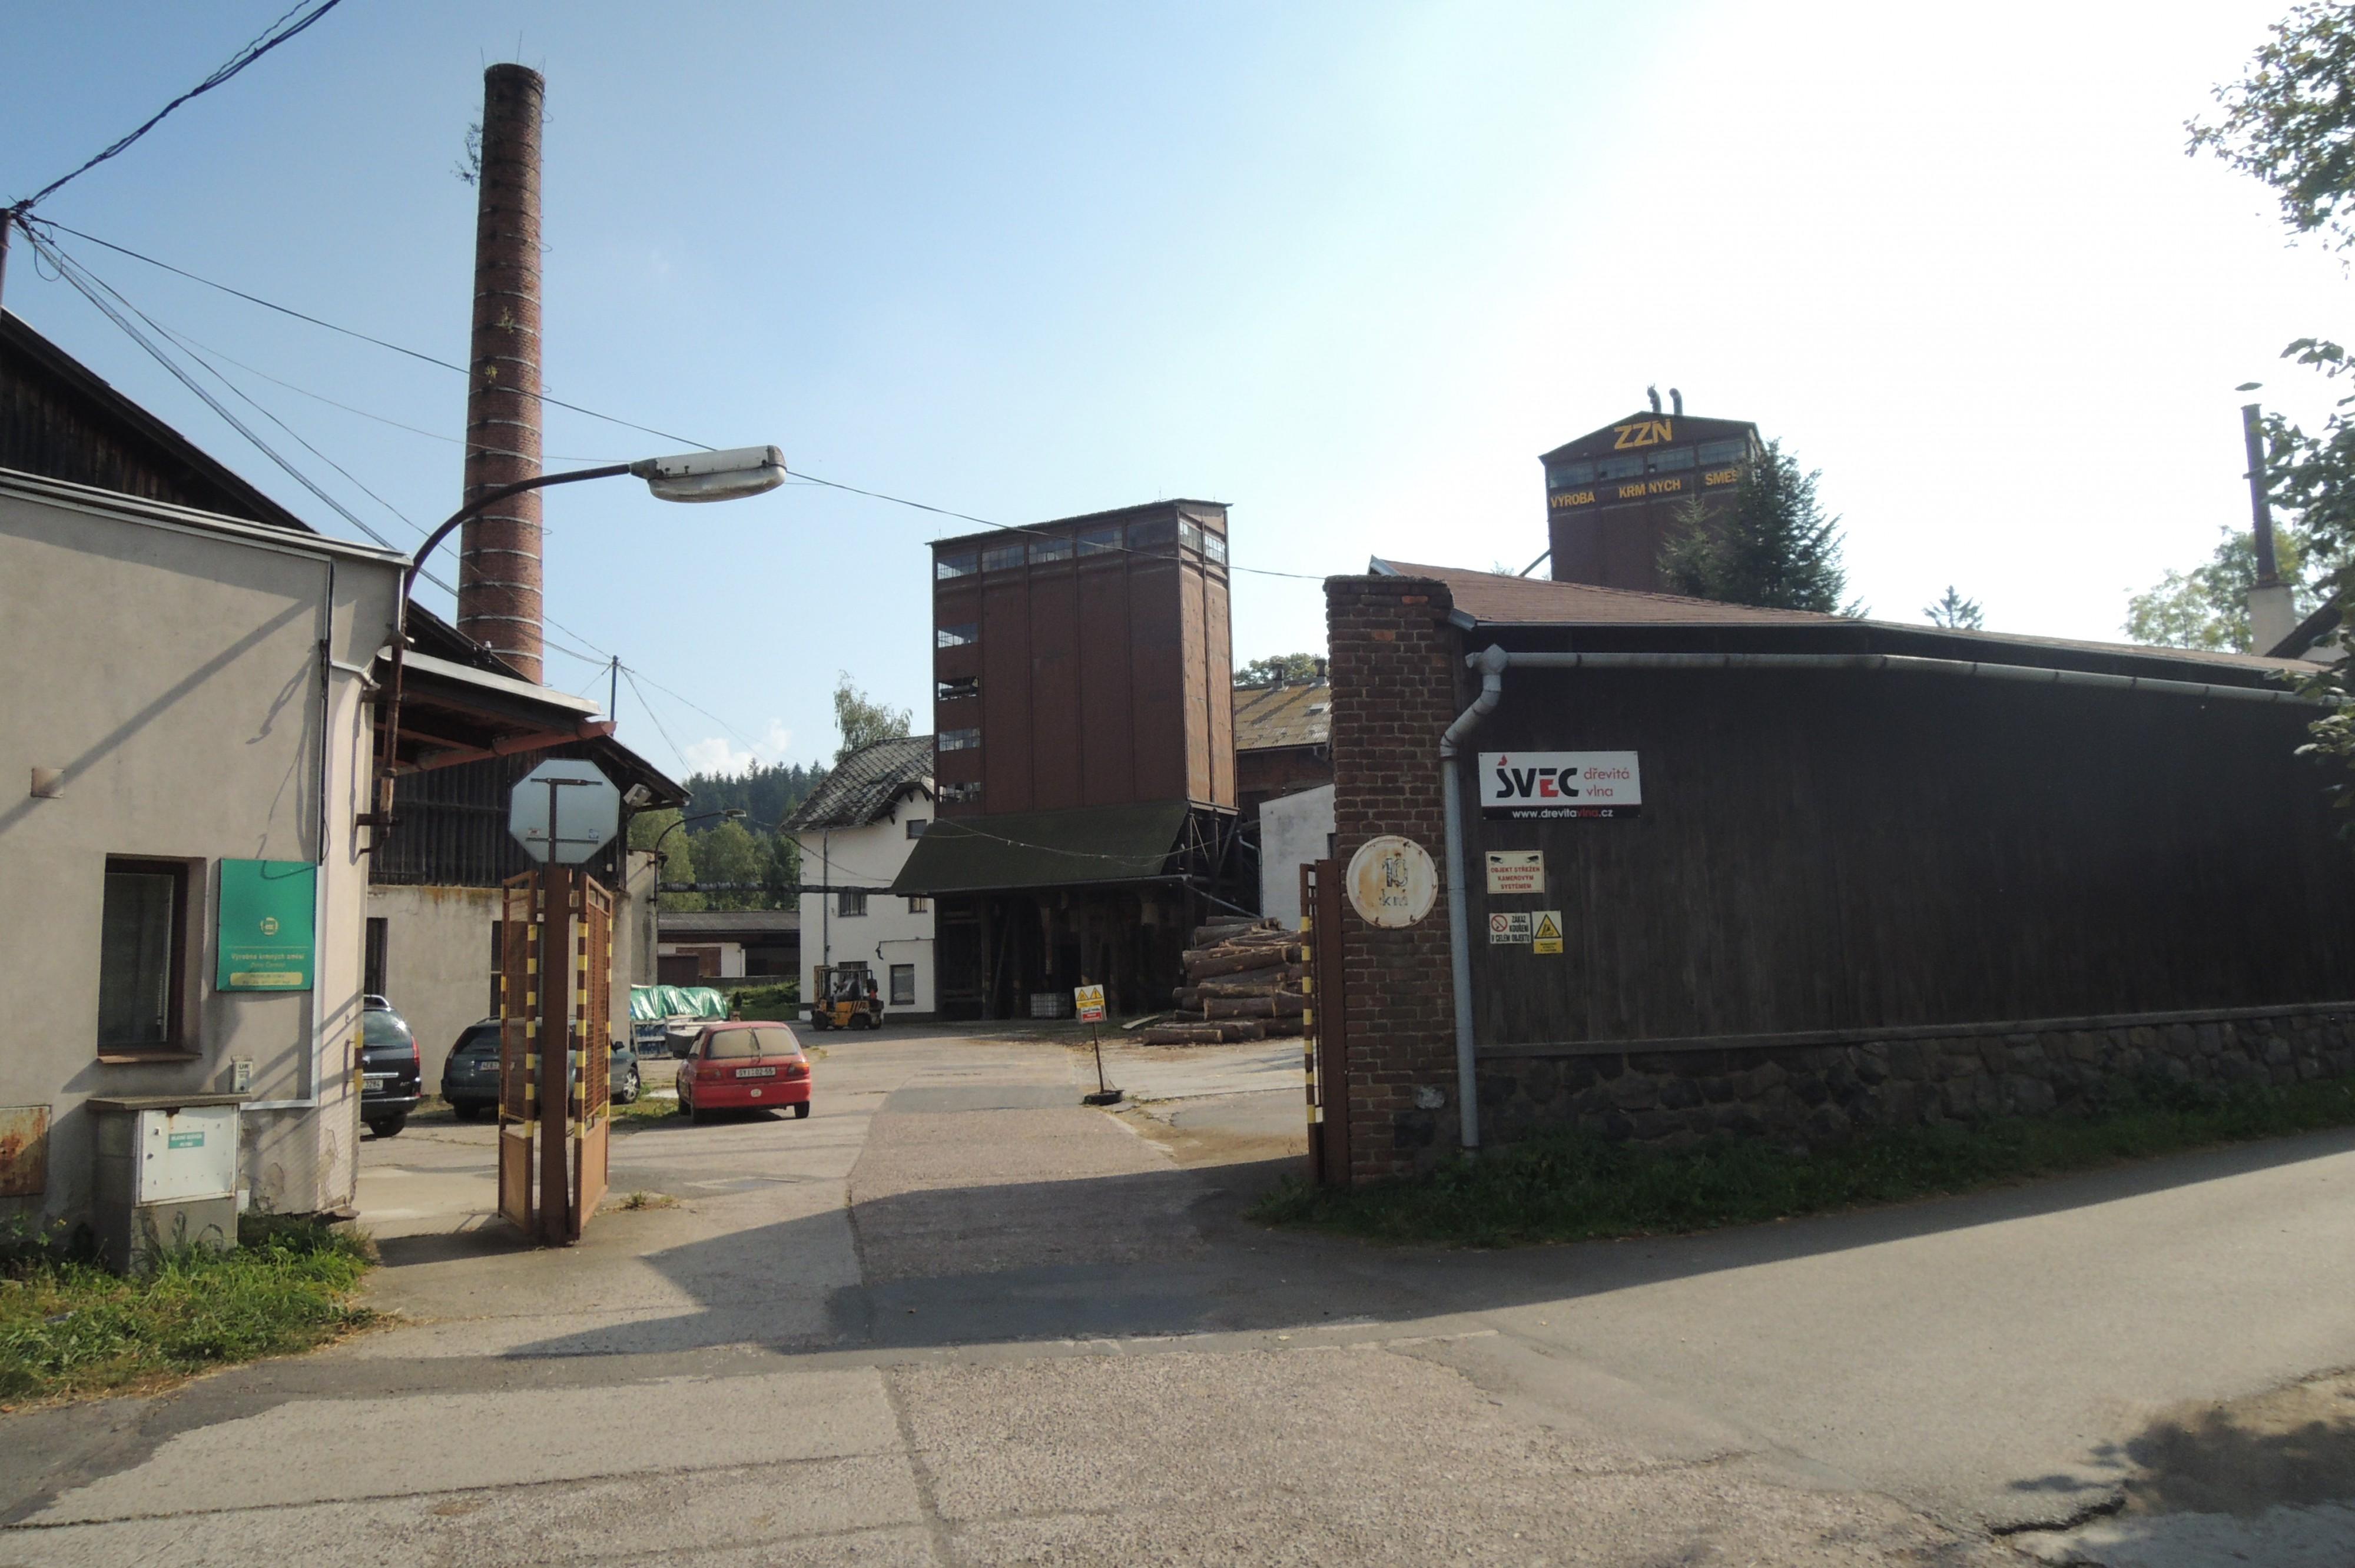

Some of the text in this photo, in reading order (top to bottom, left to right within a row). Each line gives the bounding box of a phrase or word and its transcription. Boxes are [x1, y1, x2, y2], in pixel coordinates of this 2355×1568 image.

[1614, 418, 1672, 450] ZZN
[1584, 768, 1630, 780] dřevitá
[1586, 785, 1613, 797] vlna
[1512, 808, 1613, 819] www.drevitavlna.cz
